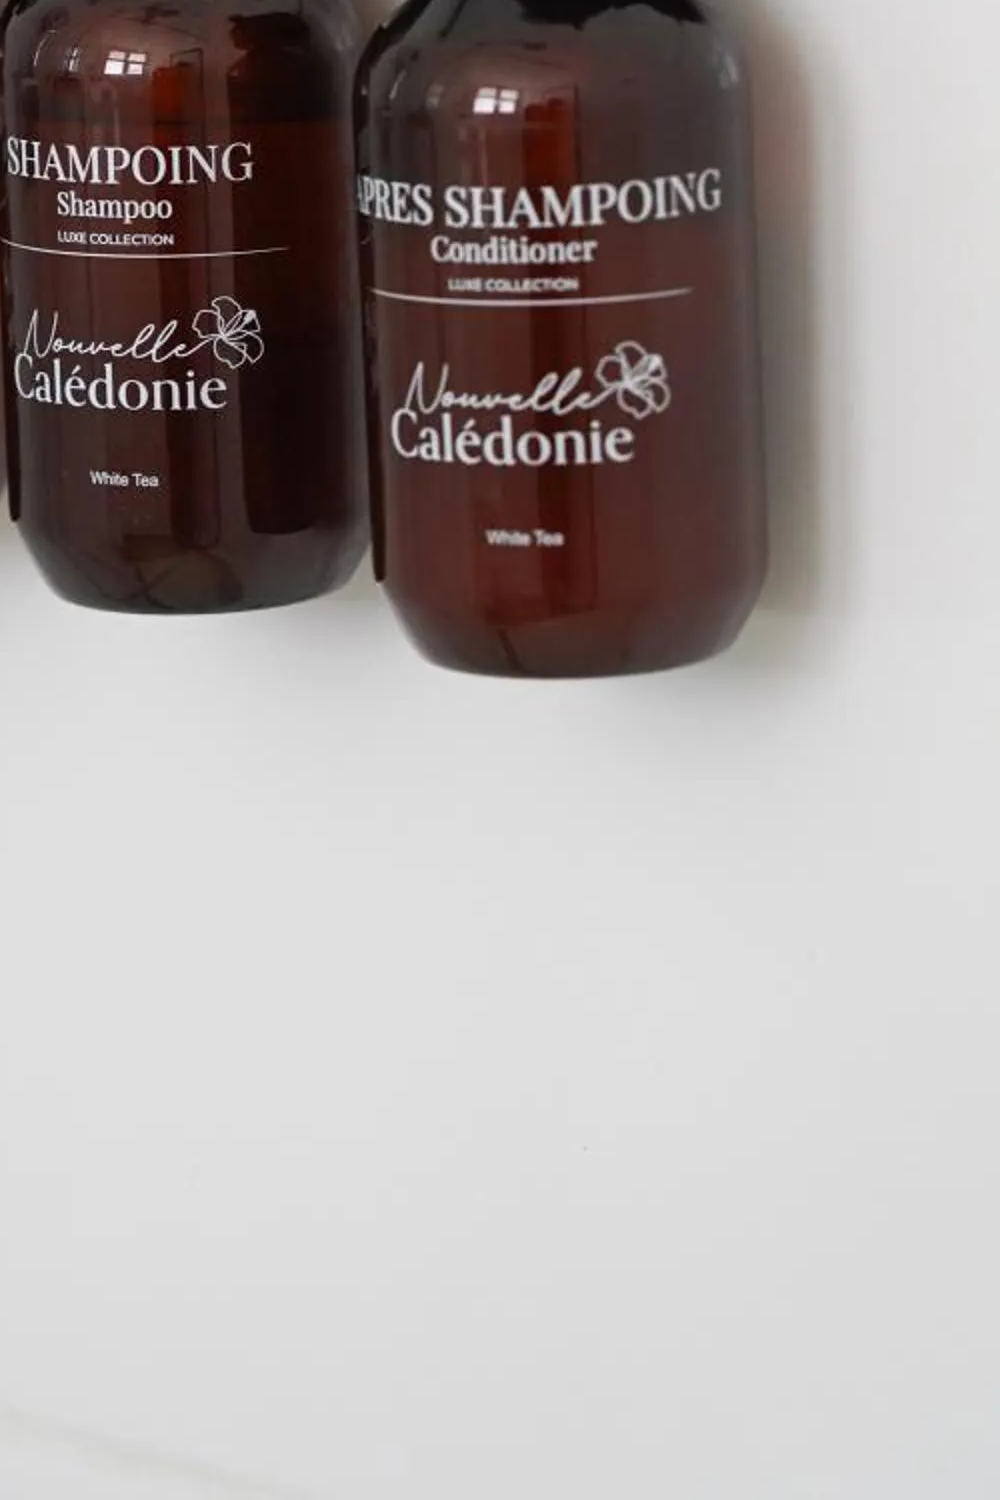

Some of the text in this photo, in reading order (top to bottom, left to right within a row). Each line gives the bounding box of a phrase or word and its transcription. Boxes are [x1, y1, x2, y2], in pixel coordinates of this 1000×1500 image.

[7, 135, 254, 186] SHAMPOING
[56, 190, 173, 225] Shampoo
[444, 168, 722, 229] SHAMPOING
[57, 230, 175, 246] LUXE COLLECTION
[430, 235, 598, 265] Conditioner
[448, 277, 579, 293] LUXE COLLECTION
[23, 308, 212, 364] Nouvelle
[14, 352, 228, 412] Calédonie
[403, 361, 618, 416] Nouvelle
[391, 407, 636, 467] Calédonie
[89, 469, 160, 488] White Tea
[485, 529, 565, 547] White Tea
